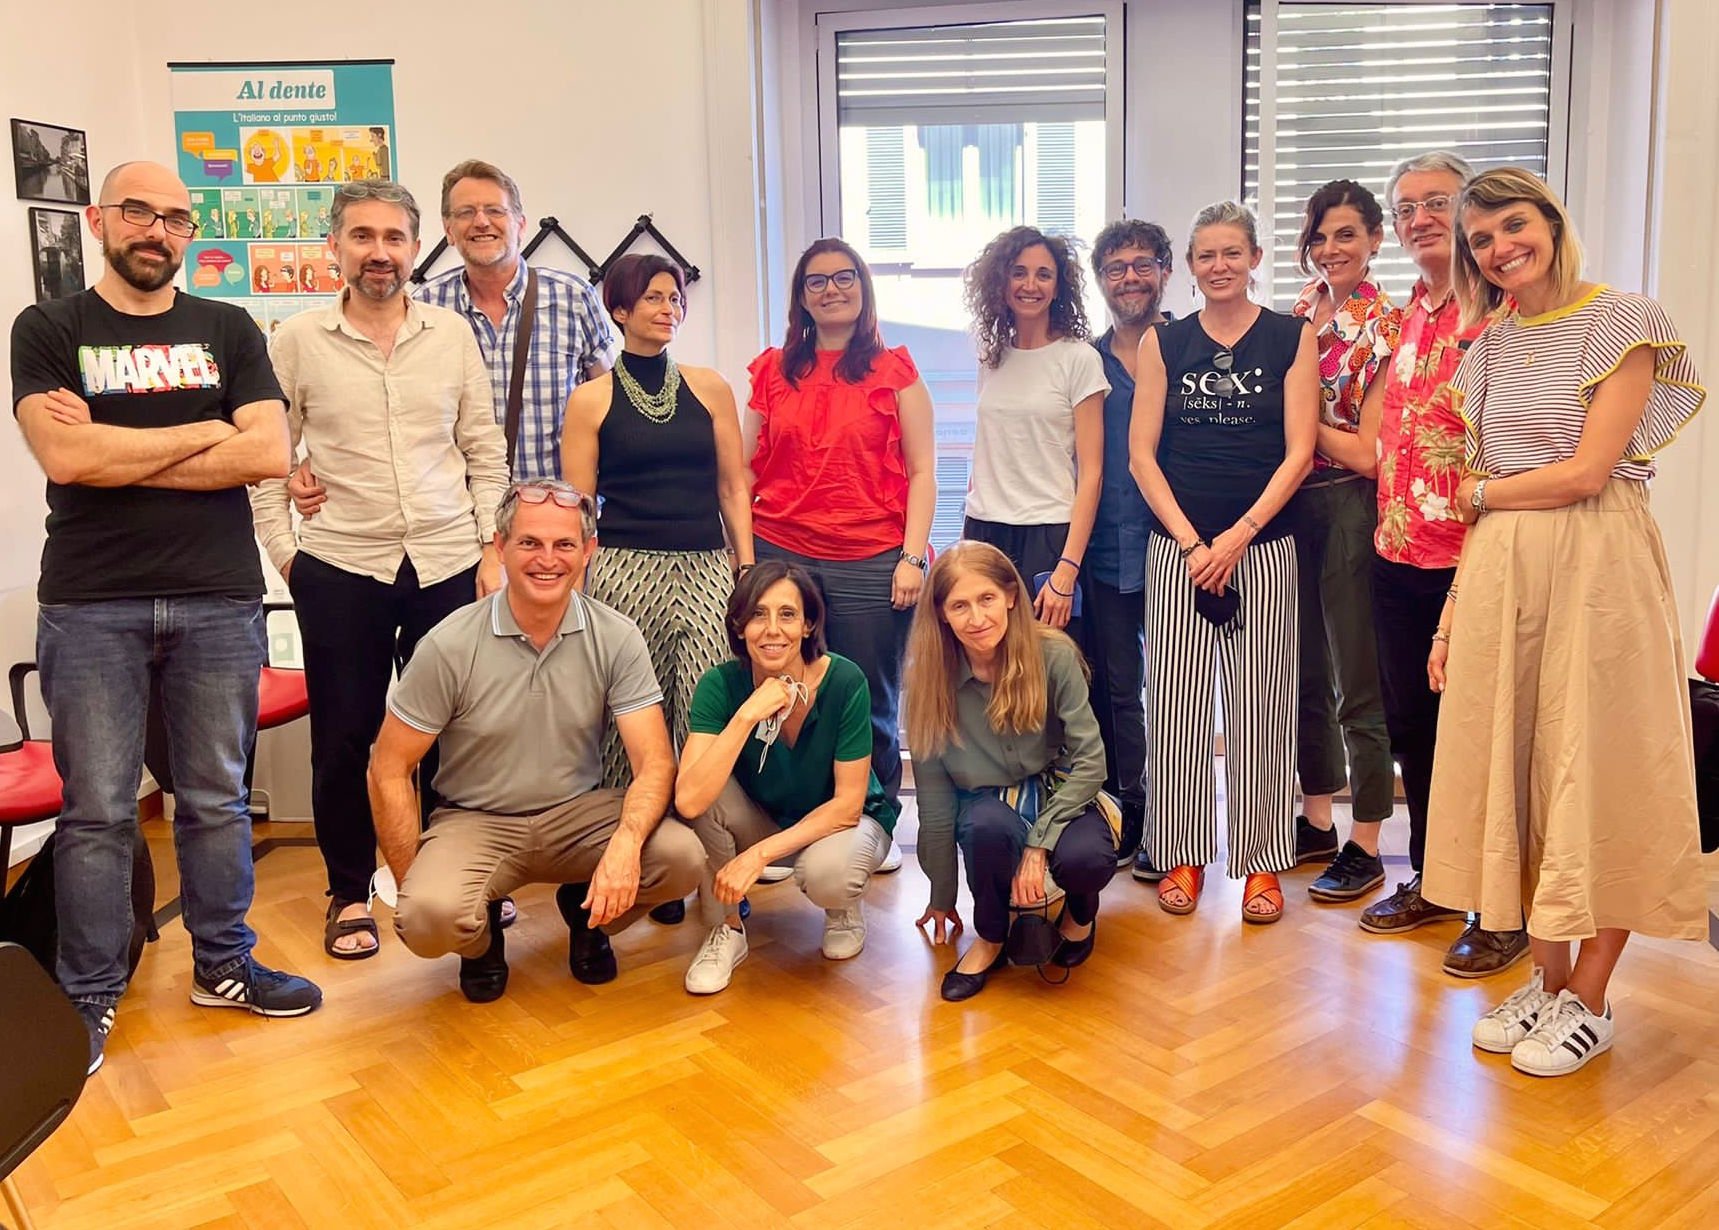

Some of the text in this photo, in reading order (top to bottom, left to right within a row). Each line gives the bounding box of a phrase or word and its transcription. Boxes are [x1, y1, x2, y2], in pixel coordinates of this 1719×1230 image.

[236, 80, 327, 99] Al dente
[232, 111, 337, 124] L'italiano al punto giusto!
[80, 344, 221, 395] MARVEL
[1180, 367, 1263, 396] sex:
[1237, 400, 1251, 409] n.
